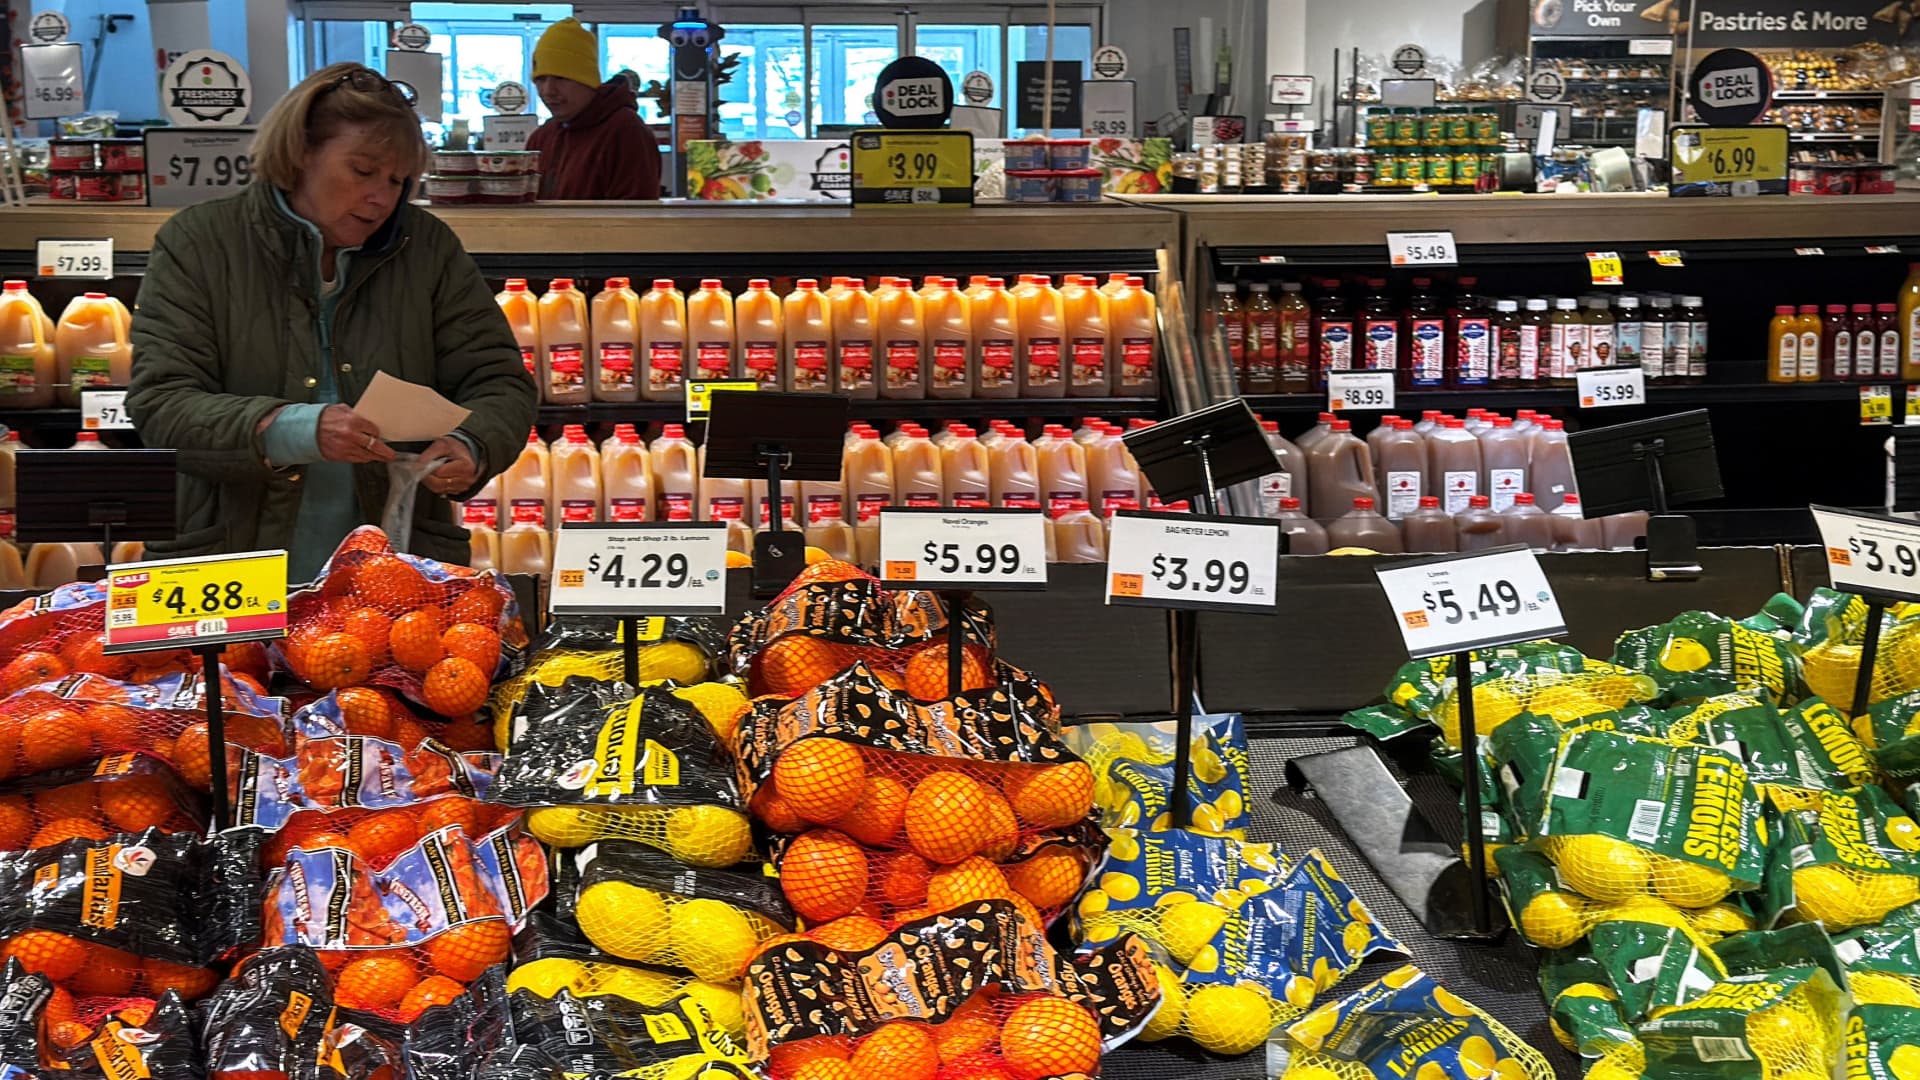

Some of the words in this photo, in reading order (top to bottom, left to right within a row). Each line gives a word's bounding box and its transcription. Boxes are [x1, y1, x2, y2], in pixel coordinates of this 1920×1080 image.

[1573, 0, 1599, 12] Pick
[1600, 0, 1637, 12] Your
[1587, 14, 1621, 28] Own
[1700, 11, 1788, 32] Pastries
[1790, 13, 1809, 31] &
[1811, 12, 1869, 31] More
[178, 90, 238, 99] FRESHNESS
[897, 84, 937, 97] DEAL
[1715, 76, 1754, 89] DEAL
[1715, 87, 1755, 101] LOCK
[898, 96, 938, 110] LOCK
[169, 155, 252, 187] $7.99
[887, 153, 938, 180] $3.99
[1708, 147, 1756, 175] $6.99
[883, 189, 911, 202] SAVE
[57, 256, 101, 272] $7.99
[1407, 245, 1447, 261] $5.49
[1345, 388, 1384, 405] $8.99
[1596, 384, 1635, 402] $5.99
[1165, 525, 1181, 535] BAG
[1182, 527, 1204, 536] MEYER
[1205, 528, 1230, 538] LEMON
[587, 552, 689, 589] $4.29
[923, 540, 1020, 575] $5.99
[1848, 535, 1920, 577] $3.9
[113, 572, 150, 585] SALE
[1151, 552, 1249, 595] $3.99
[152, 580, 244, 614] $4.88
[1422, 579, 1521, 625] $5.49
[167, 625, 194, 637] SAVE
[1683, 754, 1733, 860] LEMONS
[1719, 762, 1751, 870] SEEDLESS
[1143, 837, 1165, 897] Lemons
[1160, 849, 1176, 887] MEYER
[89, 846, 115, 927] mandarins
[1251, 915, 1266, 967] Sunkist
[913, 943, 942, 999] Oranges
[1106, 961, 1139, 1012] Oranges
[757, 971, 787, 1025] Oranges
[840, 966, 868, 1023] Oranges
[1385, 1017, 1472, 1079] Lemons
[1846, 1015, 1868, 1080] SEED
